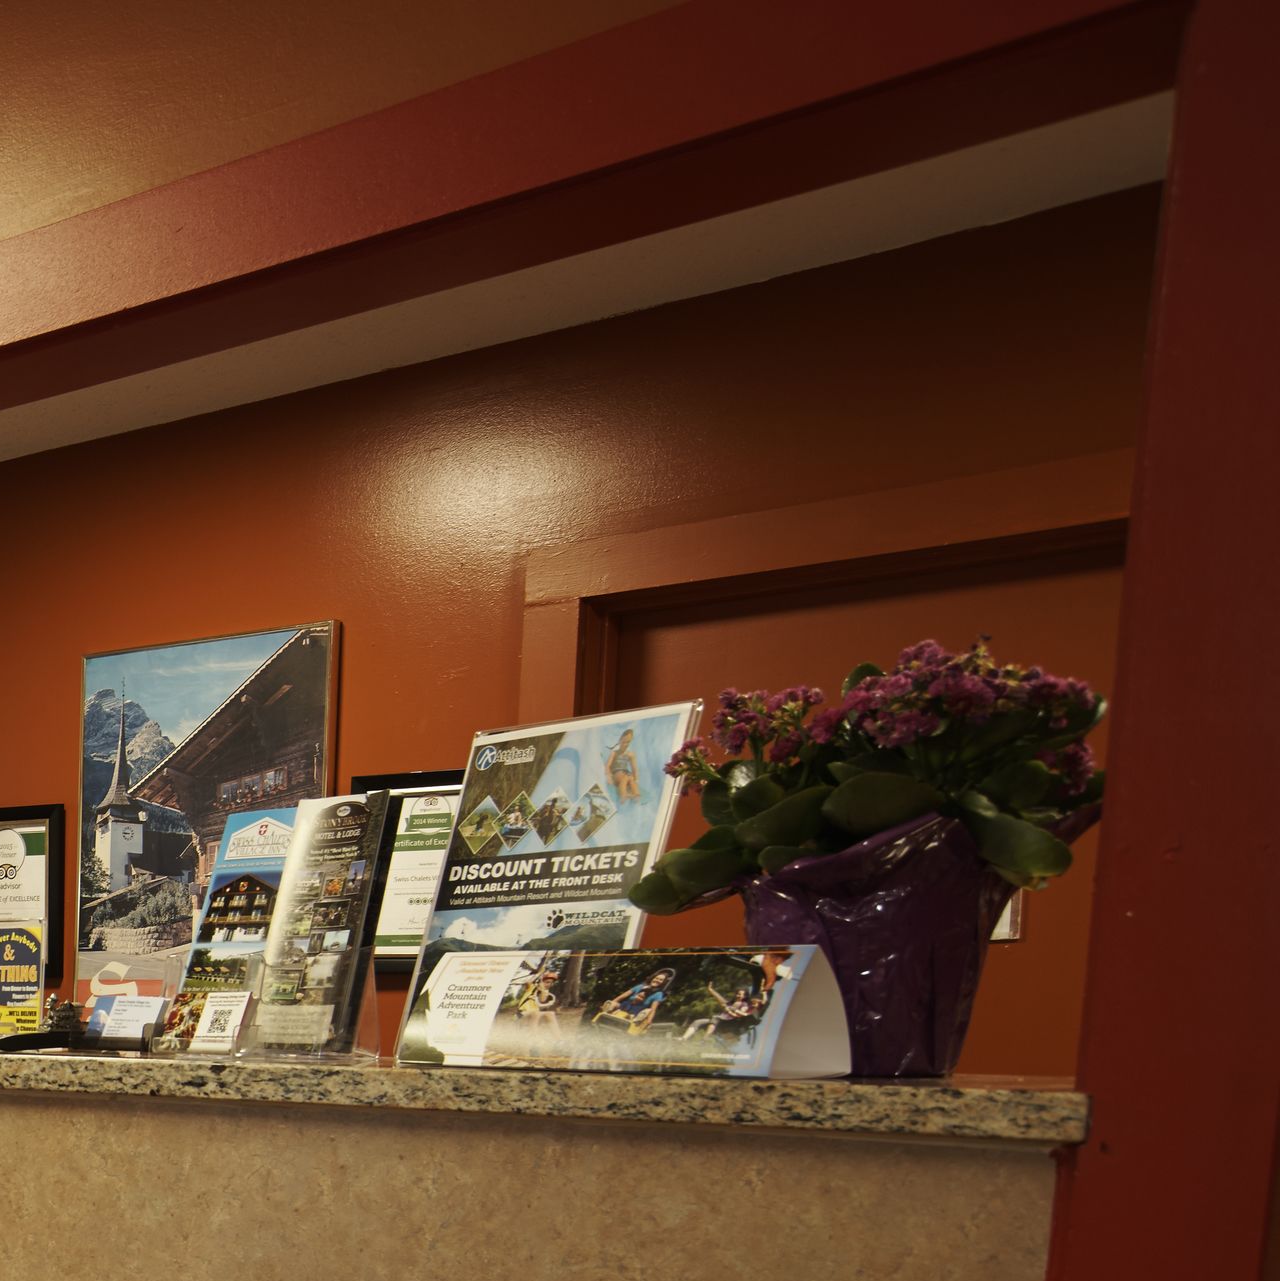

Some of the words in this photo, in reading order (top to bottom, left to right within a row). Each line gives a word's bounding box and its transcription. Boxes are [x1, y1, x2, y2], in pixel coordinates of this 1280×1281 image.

[494, 745, 536, 763] Attitash
[427, 816, 448, 824] Winner
[449, 858, 546, 882] DISCOUNT
[551, 850, 640, 873] TICKETS
[454, 881, 509, 895] AVAILABLE
[511, 880, 527, 890] AT
[528, 878, 551, 889] THE
[552, 876, 590, 887] FRONT
[591, 873, 623, 884] DESK
[449, 898, 465, 906] Valid
[466, 897, 473, 905] at
[473, 895, 496, 904] Attitash
[497, 893, 526, 902] Mountain
[527, 892, 548, 900] Resort
[549, 891, 562, 899] and
[564, 889, 589, 898] Wildcat
[590, 887, 622, 896] Mountain
[564, 910, 625, 919] WILDCAT
[10, 932, 38, 953] Anybody
[3, 943, 15, 961] &
[447, 984, 492, 992] Cranmore
[443, 992, 487, 1001] Mountain
[437, 1001, 486, 1010] Adventure
[446, 1011, 468, 1019] Park
